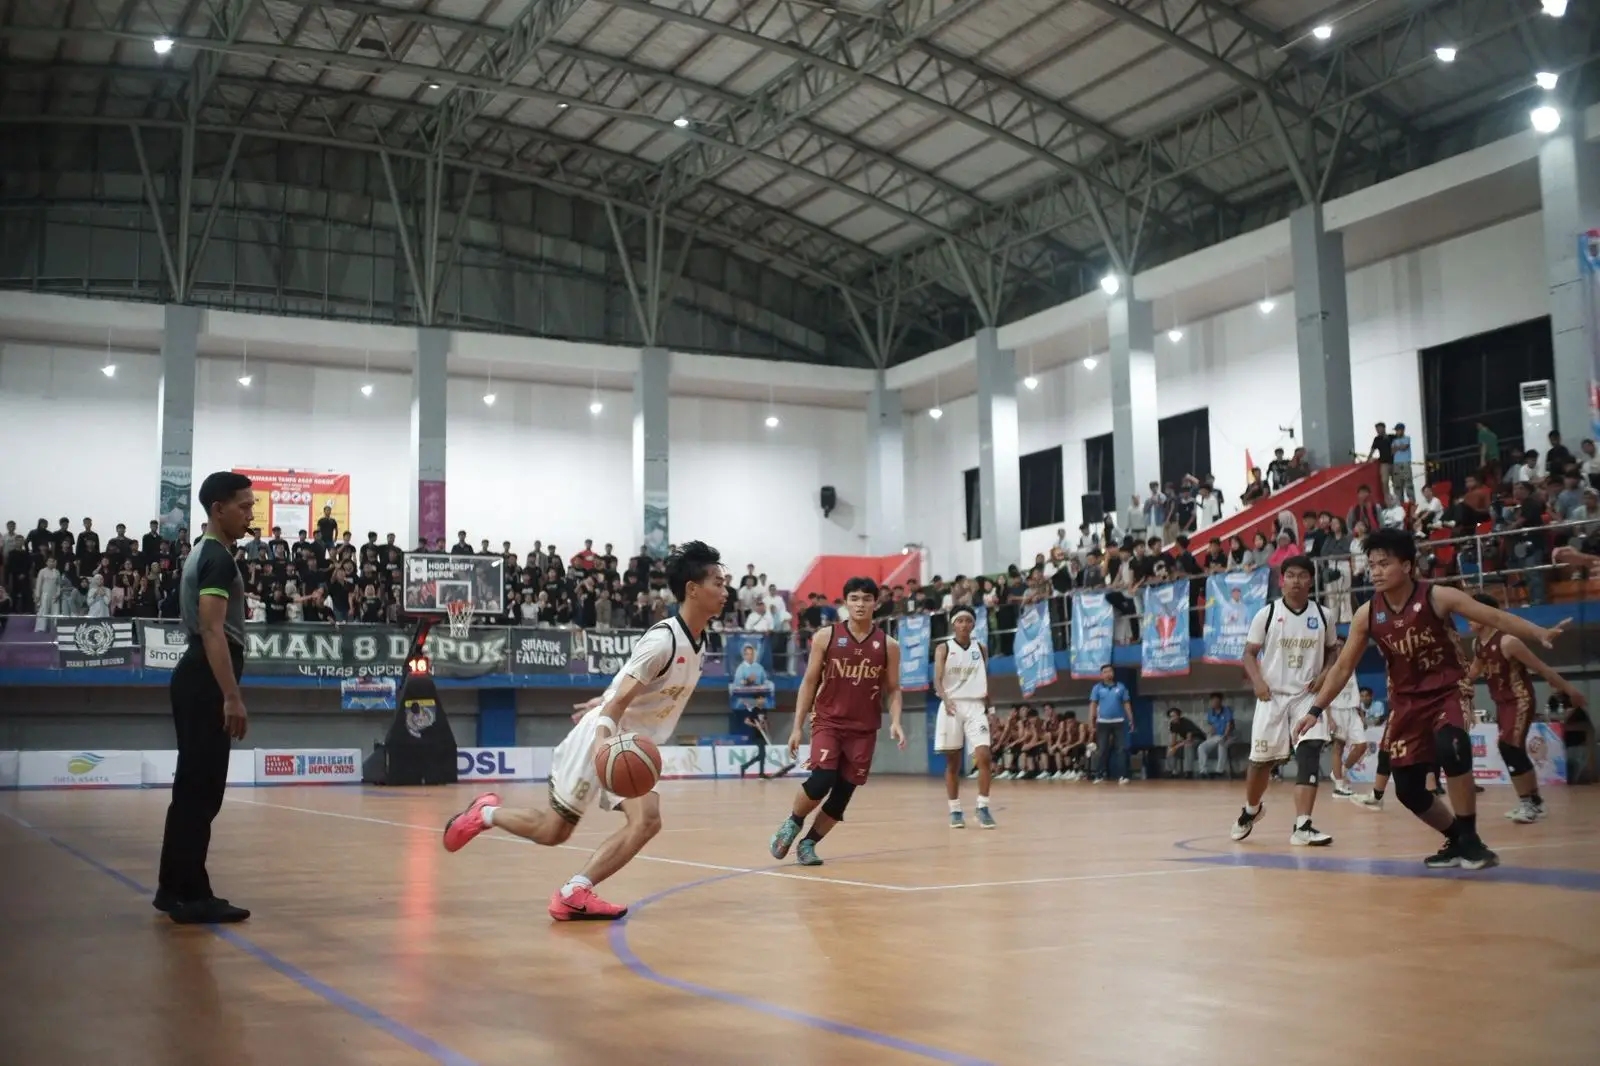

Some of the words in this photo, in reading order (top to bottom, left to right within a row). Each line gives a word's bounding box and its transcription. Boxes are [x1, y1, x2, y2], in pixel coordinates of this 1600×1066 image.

[246, 632, 343, 661] MAN
[354, 634, 377, 661] 8
[299, 664, 353, 677] ULTRAS
[819, 749, 829, 763] 7
[308, 765, 333, 774] DEPOK
